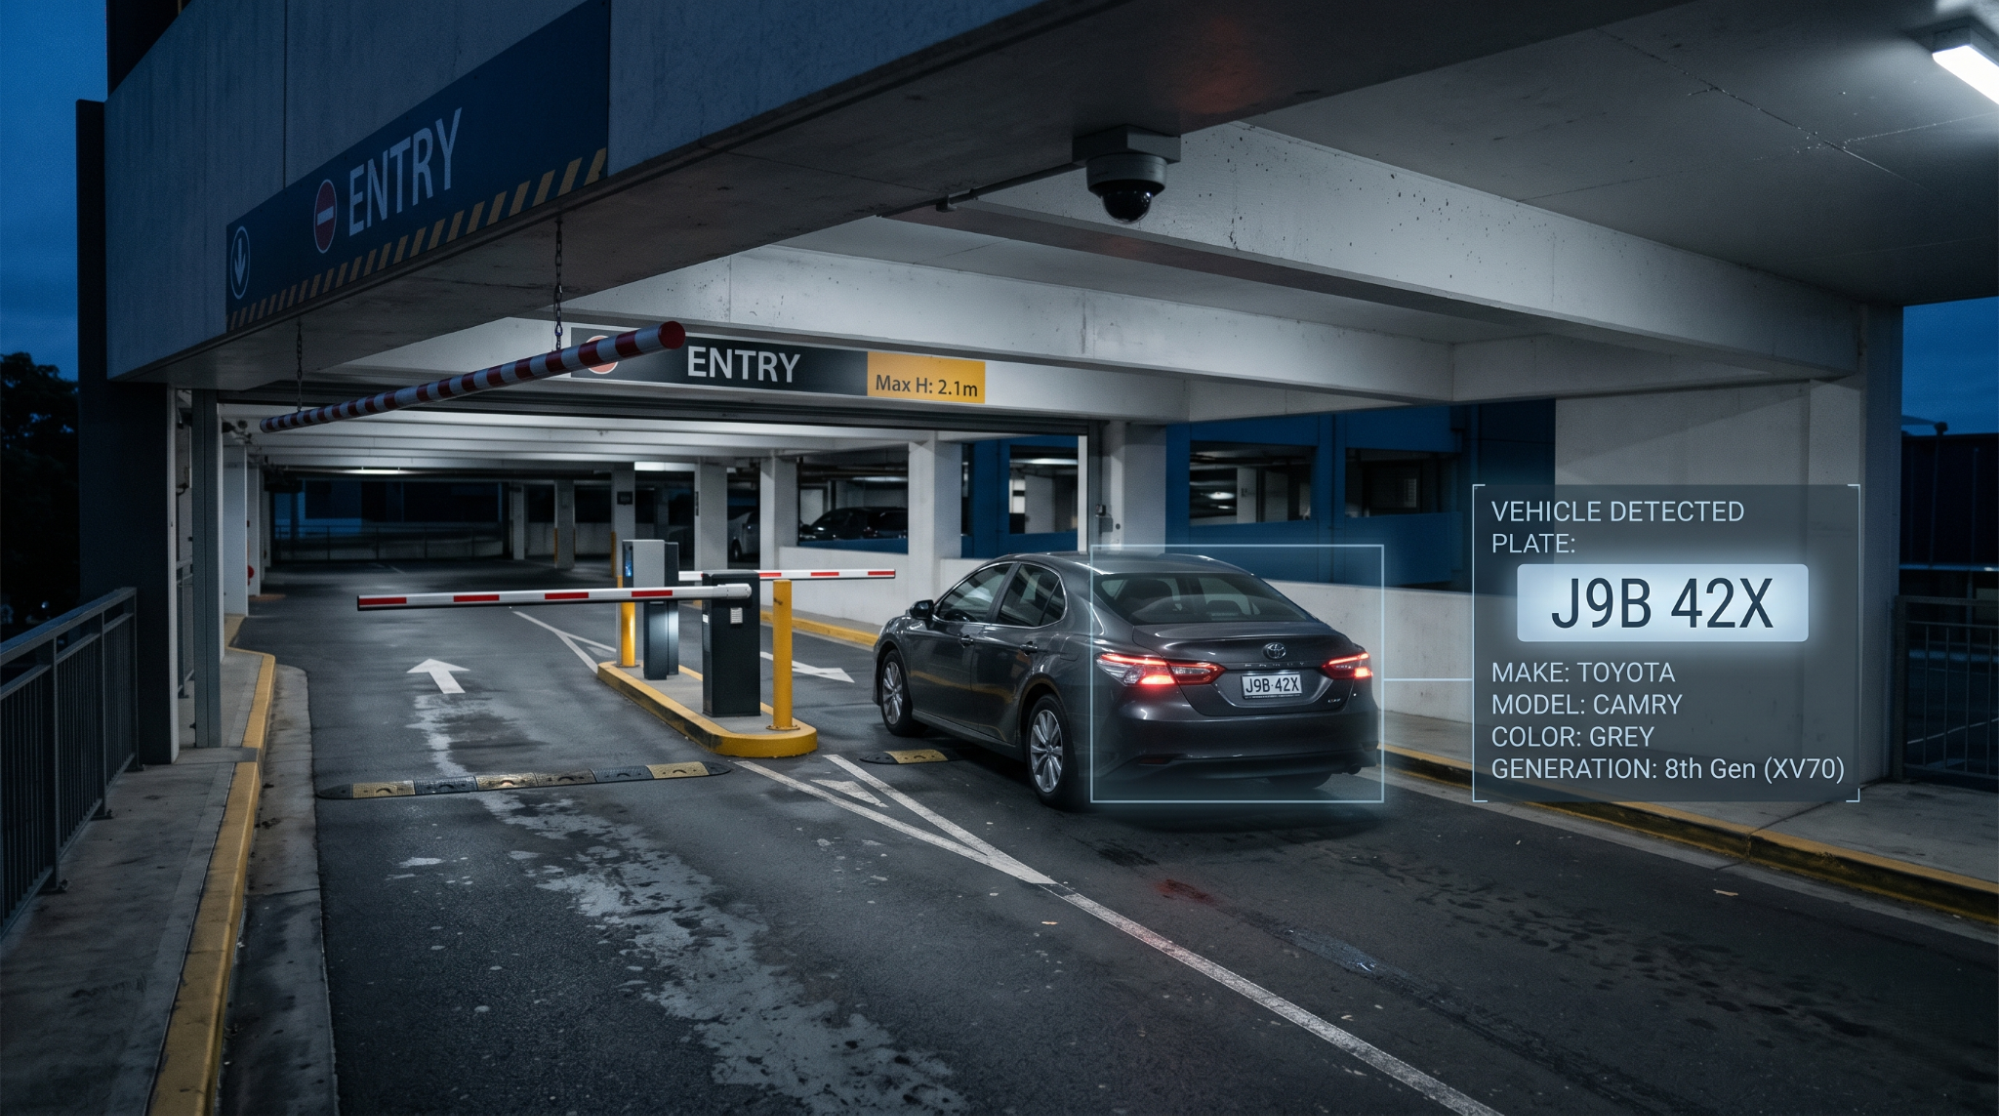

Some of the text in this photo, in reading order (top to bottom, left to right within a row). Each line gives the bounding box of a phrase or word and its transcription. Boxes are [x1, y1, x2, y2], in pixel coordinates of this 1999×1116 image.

[347, 106, 462, 238] ENTRY
[687, 345, 801, 384] ENTRY
[874, 374, 979, 398] Max H: 2.1m
